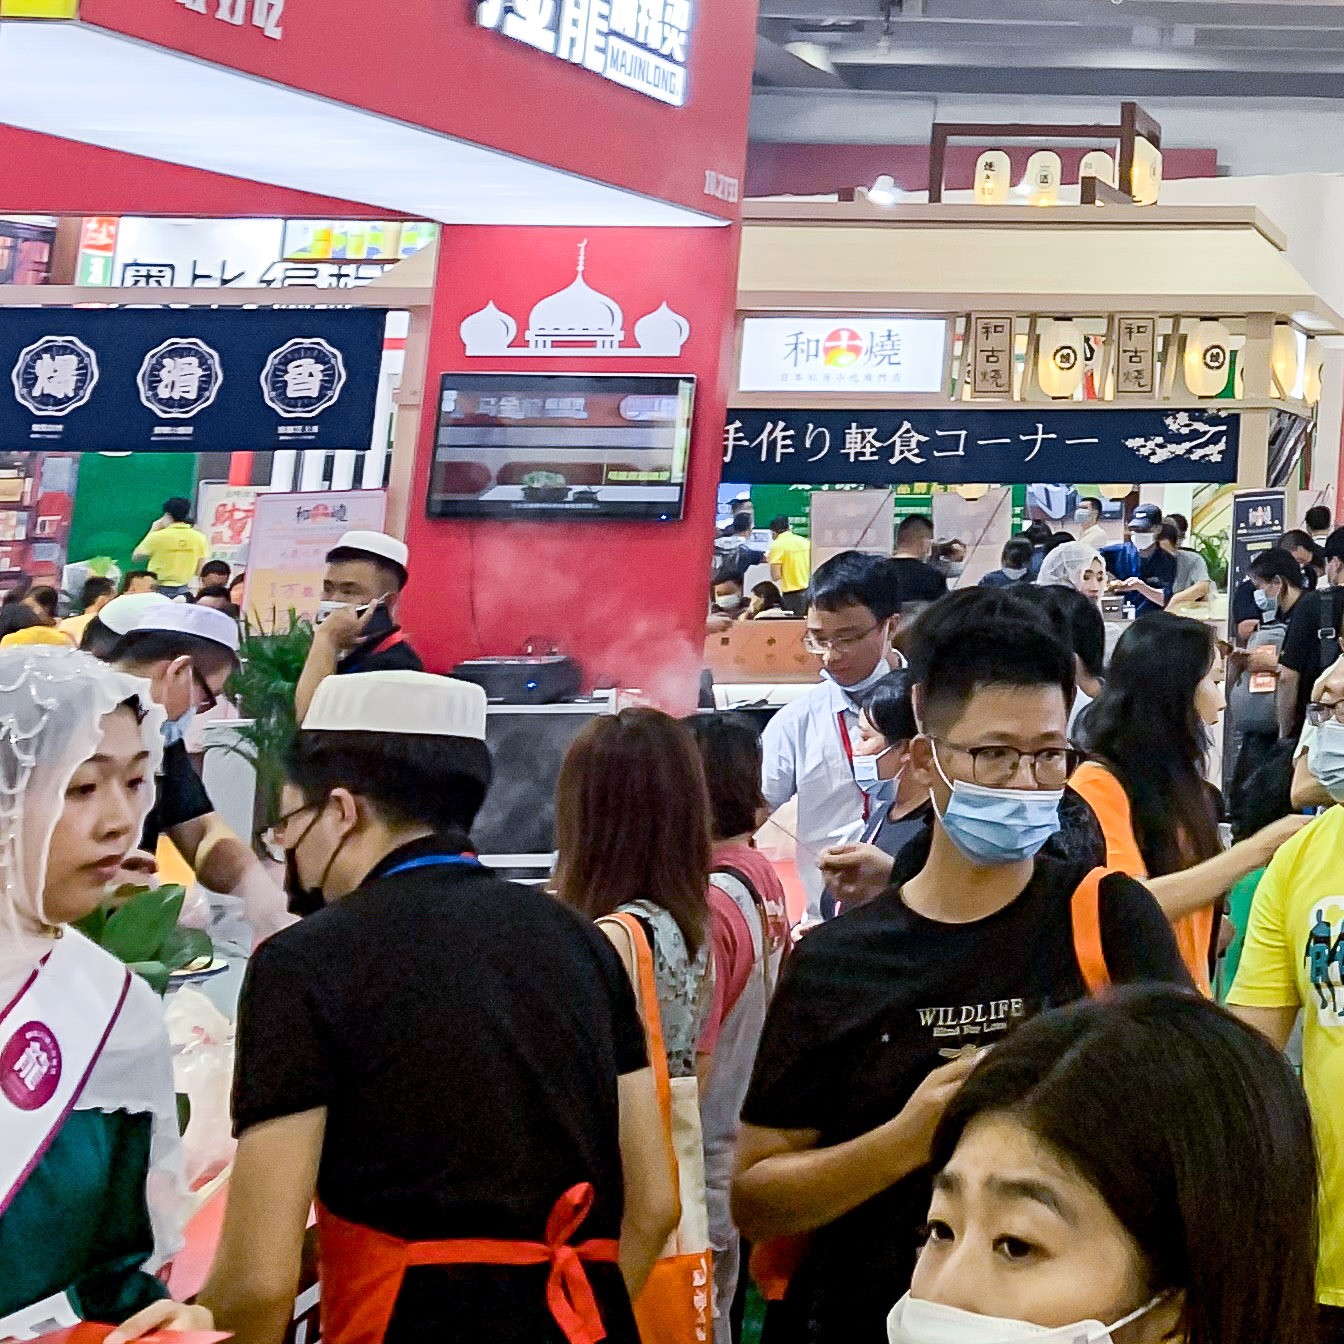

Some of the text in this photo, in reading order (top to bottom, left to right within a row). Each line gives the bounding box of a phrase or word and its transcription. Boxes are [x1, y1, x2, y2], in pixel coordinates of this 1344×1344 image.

[284, 359, 324, 398] 香
[723, 420, 1099, 465] 手作り軽食コーナー
[916, 997, 1023, 1026] WILDLIFE
